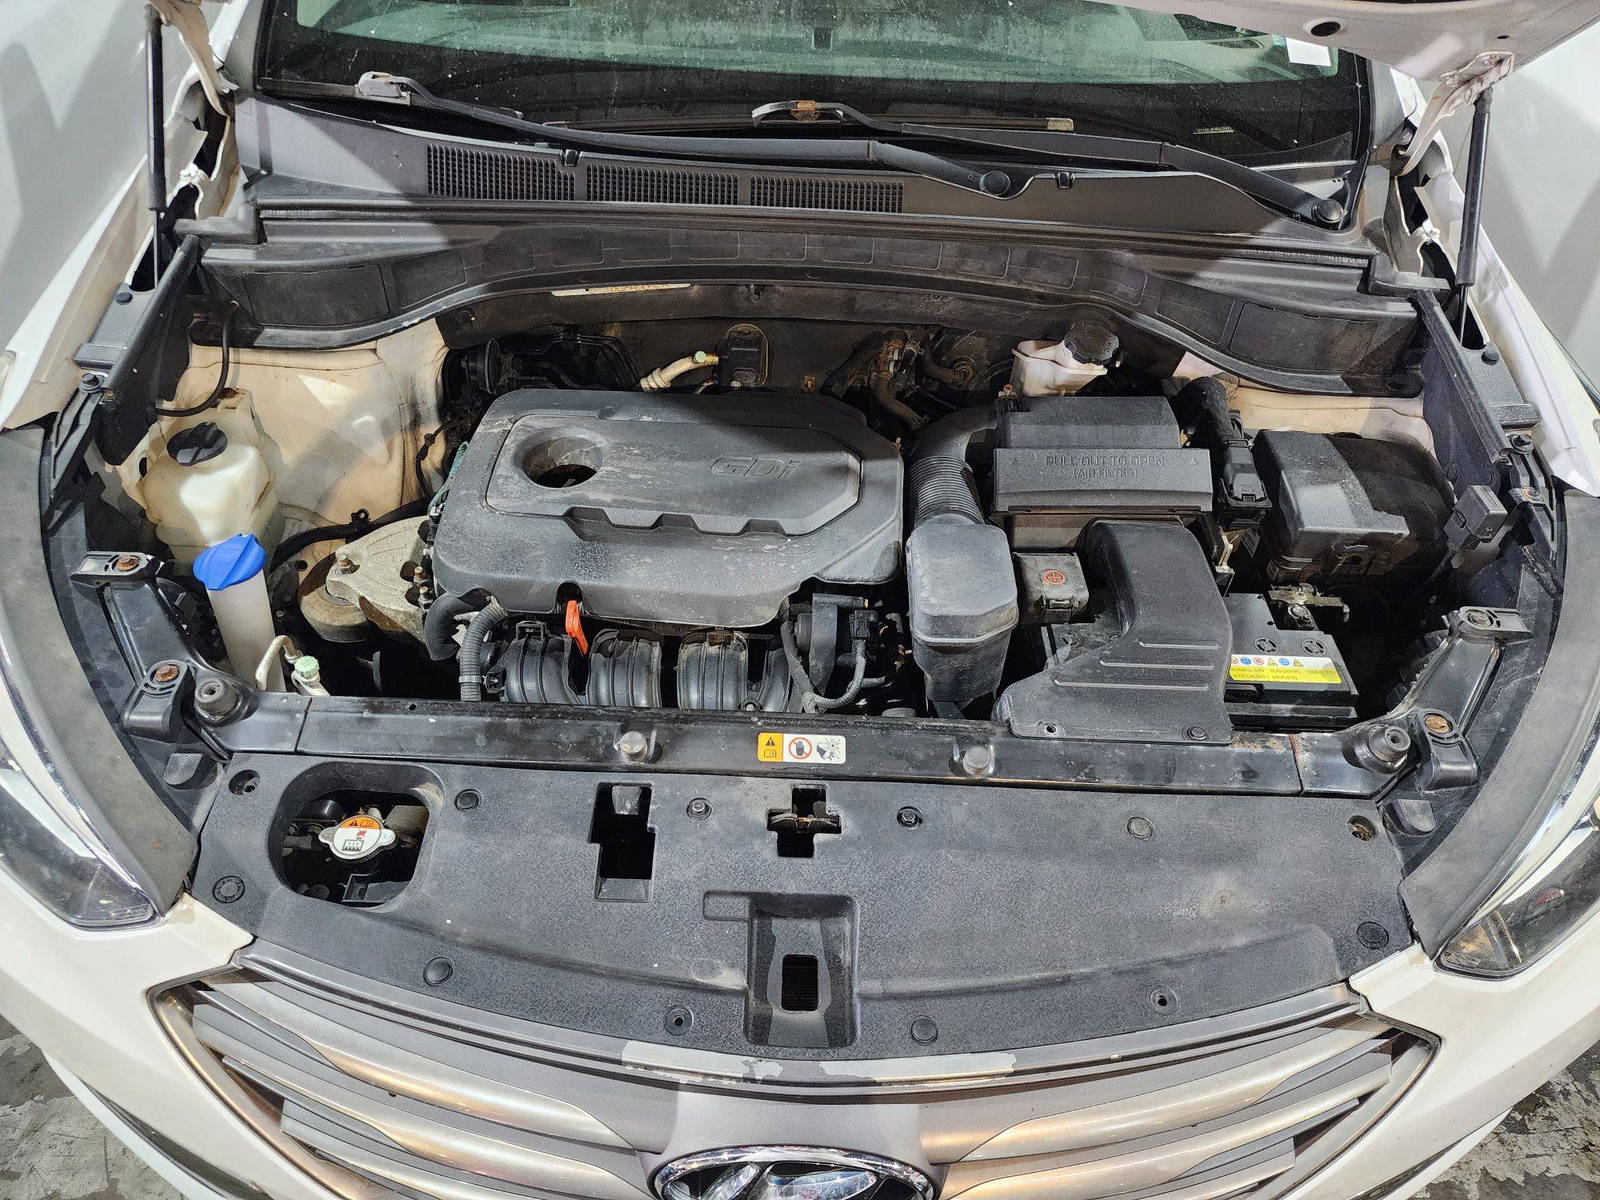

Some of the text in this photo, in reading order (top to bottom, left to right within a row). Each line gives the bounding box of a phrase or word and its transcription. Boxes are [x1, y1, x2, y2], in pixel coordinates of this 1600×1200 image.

[709, 456, 801, 479] GDI
[1045, 455, 1165, 467] PULL OUT TO OPEN
